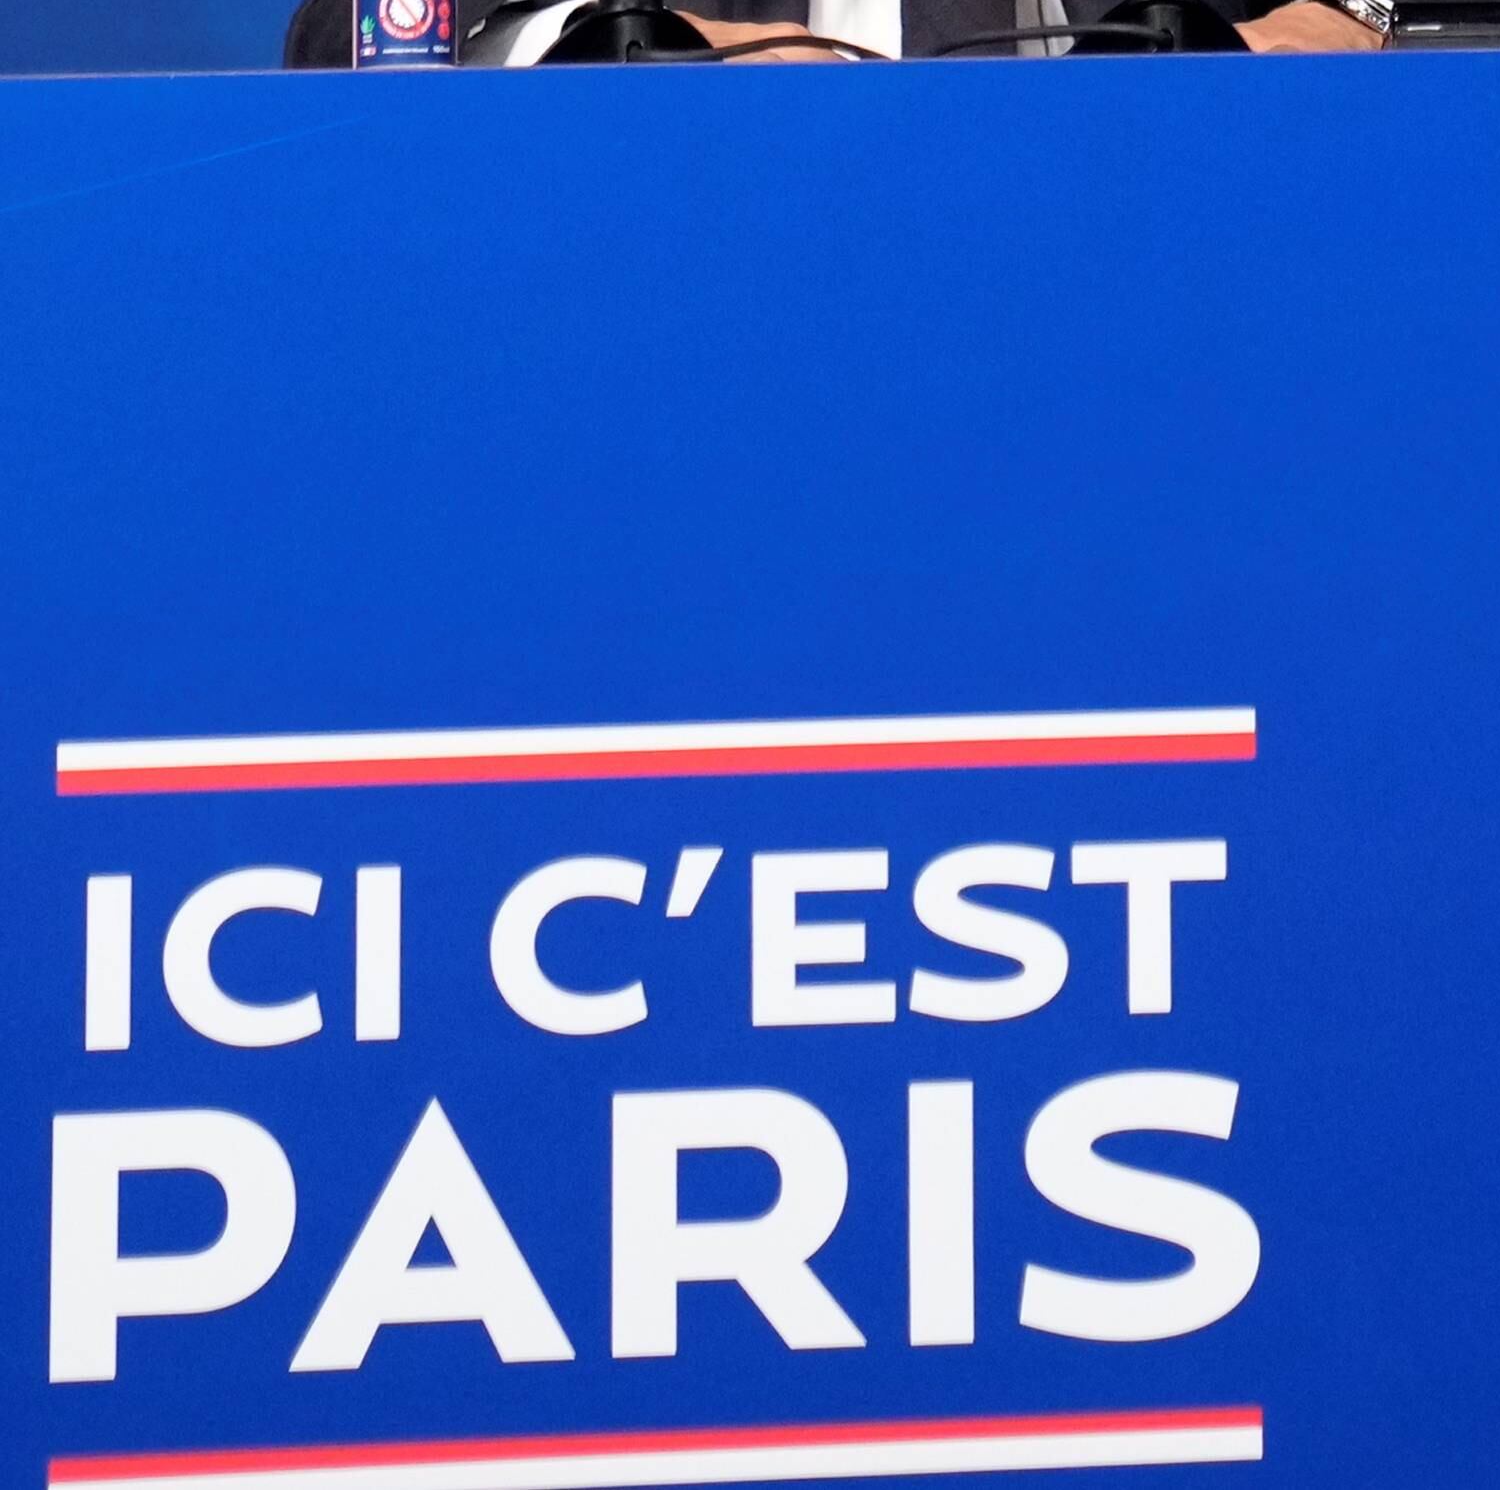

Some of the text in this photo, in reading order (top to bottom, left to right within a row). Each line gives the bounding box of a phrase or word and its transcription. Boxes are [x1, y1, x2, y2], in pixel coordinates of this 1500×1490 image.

[85, 837, 1228, 1052] ICI C'EST
[48, 1069, 1262, 1384] PARIS
